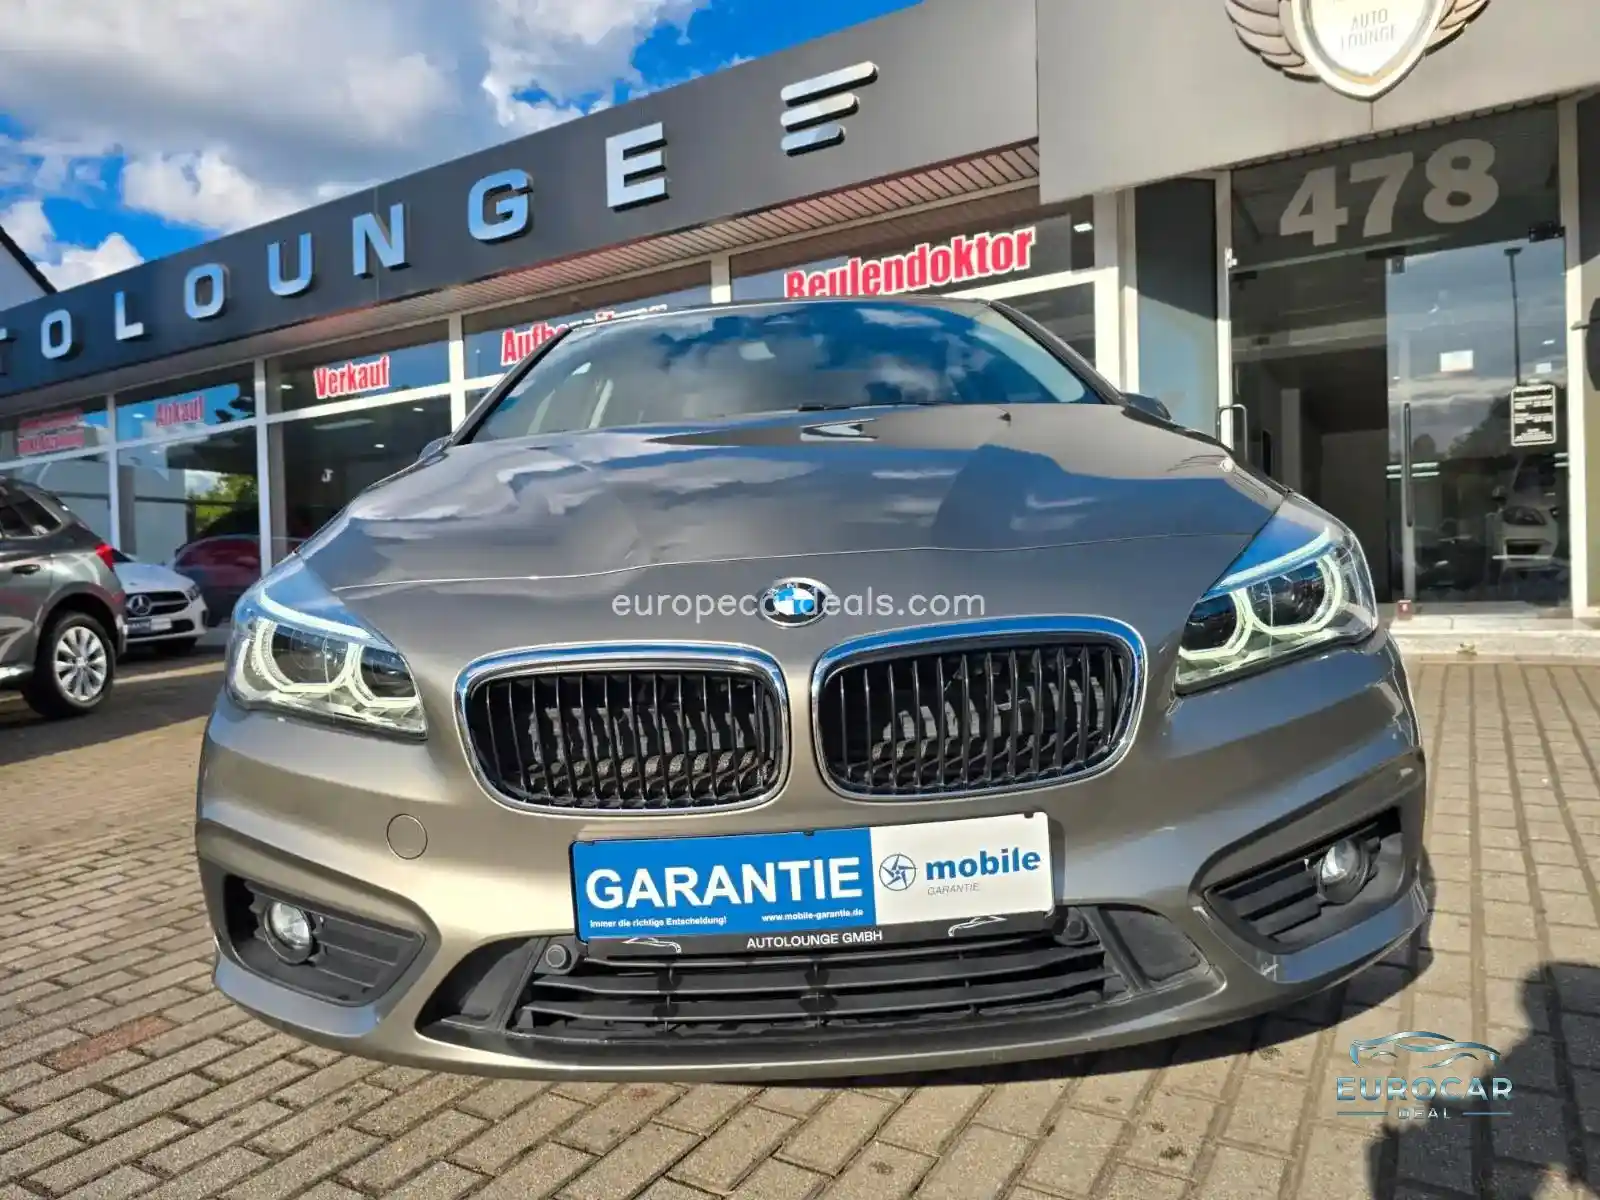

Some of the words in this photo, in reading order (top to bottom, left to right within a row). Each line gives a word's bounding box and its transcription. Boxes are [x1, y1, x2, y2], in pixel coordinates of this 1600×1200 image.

[1350, 8, 1388, 31] AUTO
[1280, 139, 1499, 246] 478
[0, 122, 666, 359] OLOUNGE
[784, 227, 1036, 298] Beulendoktor
[314, 353, 391, 399] Verkauf
[926, 847, 1041, 881] mobile
[586, 857, 864, 910] GARANTIE
[927, 882, 981, 896] GARANTIE
[618, 919, 632, 928] die
[761, 907, 864, 922] www.mobile-garantie.de
[746, 932, 839, 949] AUTOLOUNGE
[841, 929, 883, 944] GMBH
